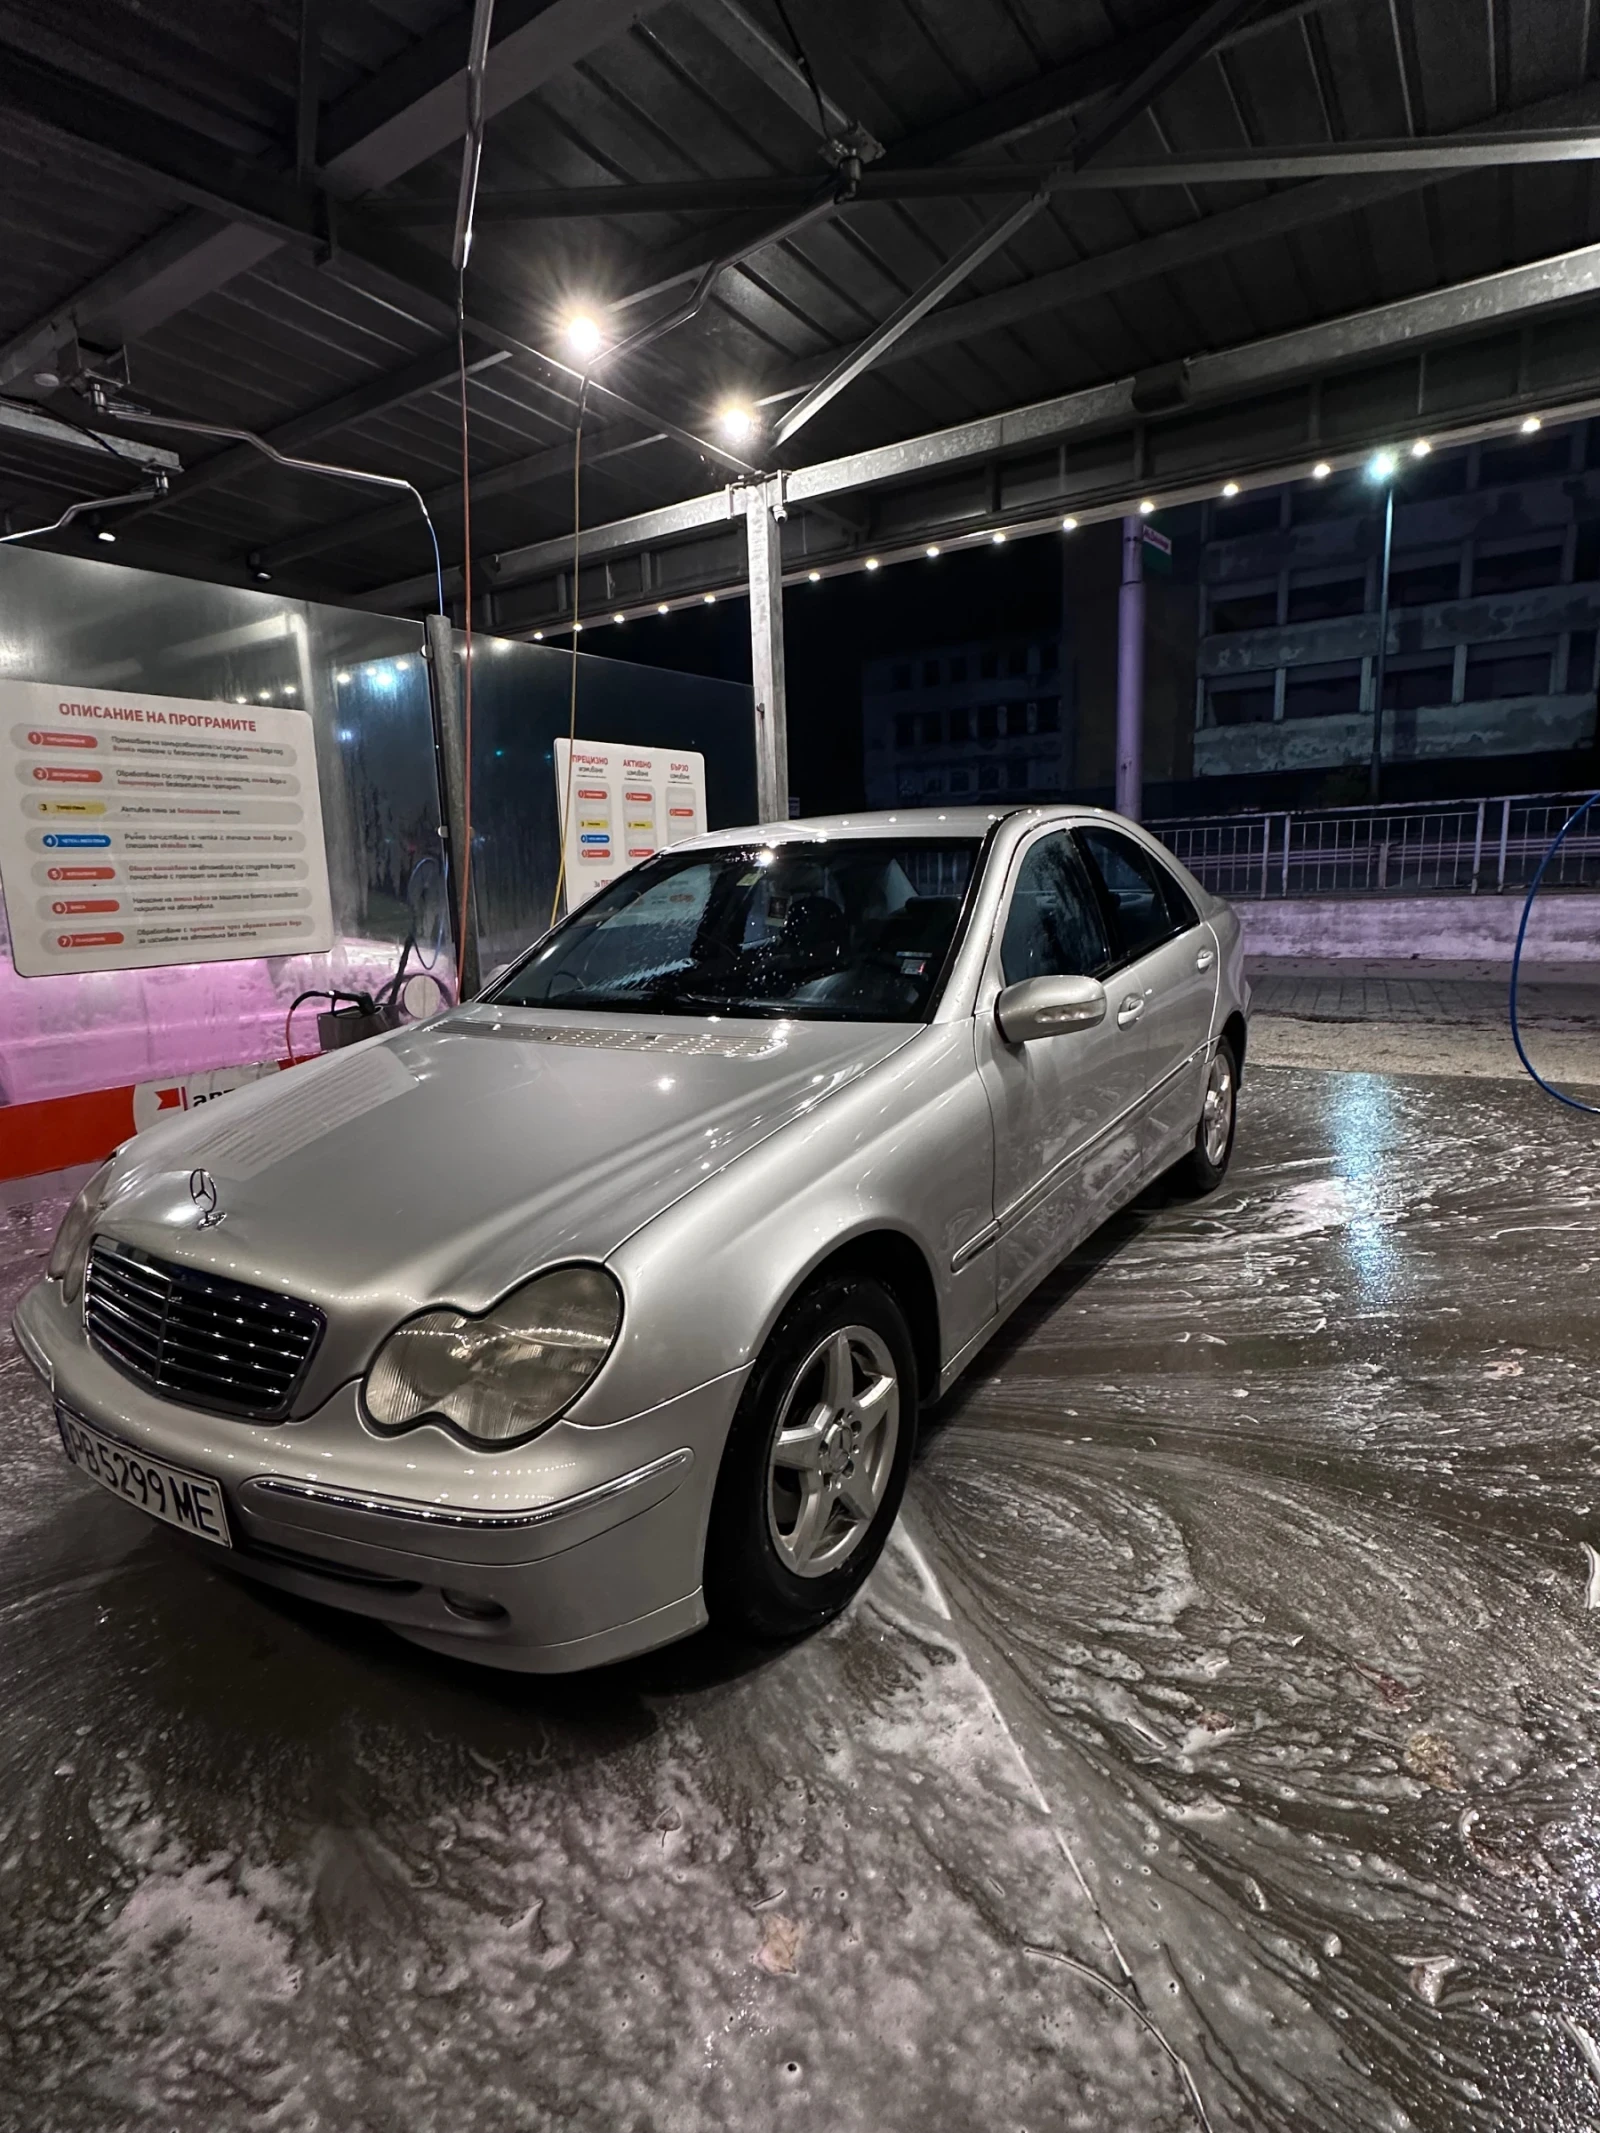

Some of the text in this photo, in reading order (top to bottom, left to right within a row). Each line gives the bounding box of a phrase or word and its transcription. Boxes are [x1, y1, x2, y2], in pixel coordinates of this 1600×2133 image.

[59, 703, 257, 732] ОПИСАНИЕ НА ПРОГРАМИТЕ
[31, 735, 39, 743] 1
[572, 755, 608, 765] ПРЕЦИЗНО
[623, 760, 652, 768] АКТИВНО
[671, 764, 689, 772] БЪРЗО
[46, 837, 53, 845] 4
[51, 870, 58, 879] 5
[62, 937, 68, 946] 7
